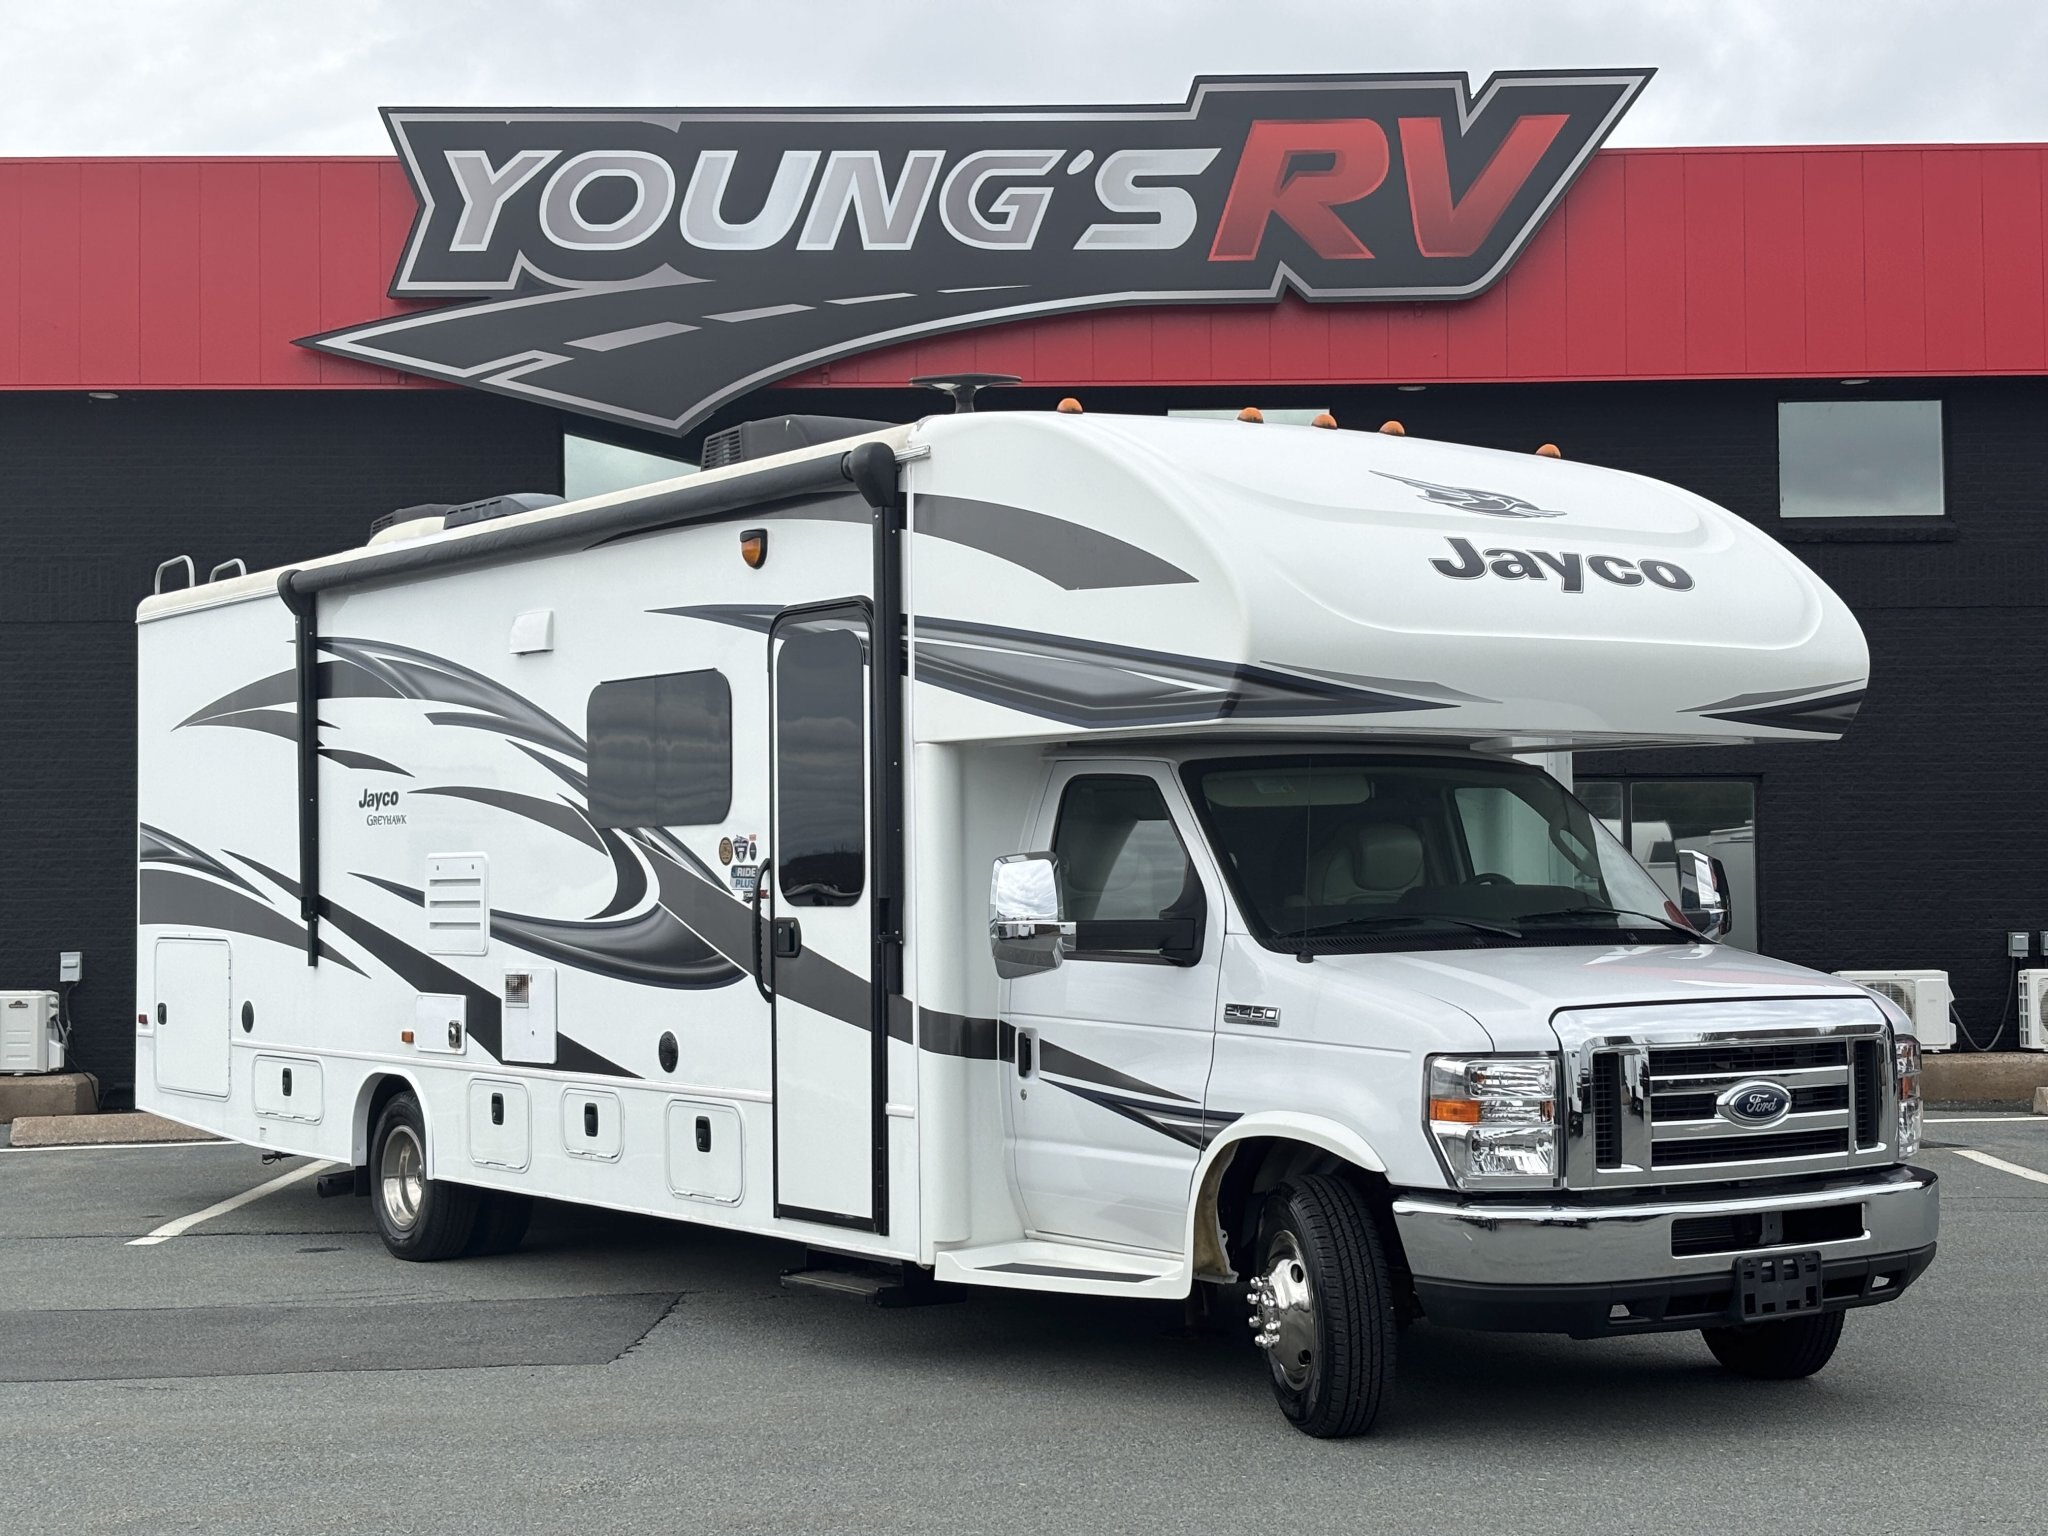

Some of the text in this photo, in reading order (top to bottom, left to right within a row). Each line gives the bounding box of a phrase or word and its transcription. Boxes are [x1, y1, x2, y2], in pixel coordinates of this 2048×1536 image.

[443, 114, 1571, 262] YOUNG'S RV
[1428, 536, 1696, 594] Jayco
[358, 788, 399, 811] Jayco
[1746, 1093, 1777, 1113] Ford
